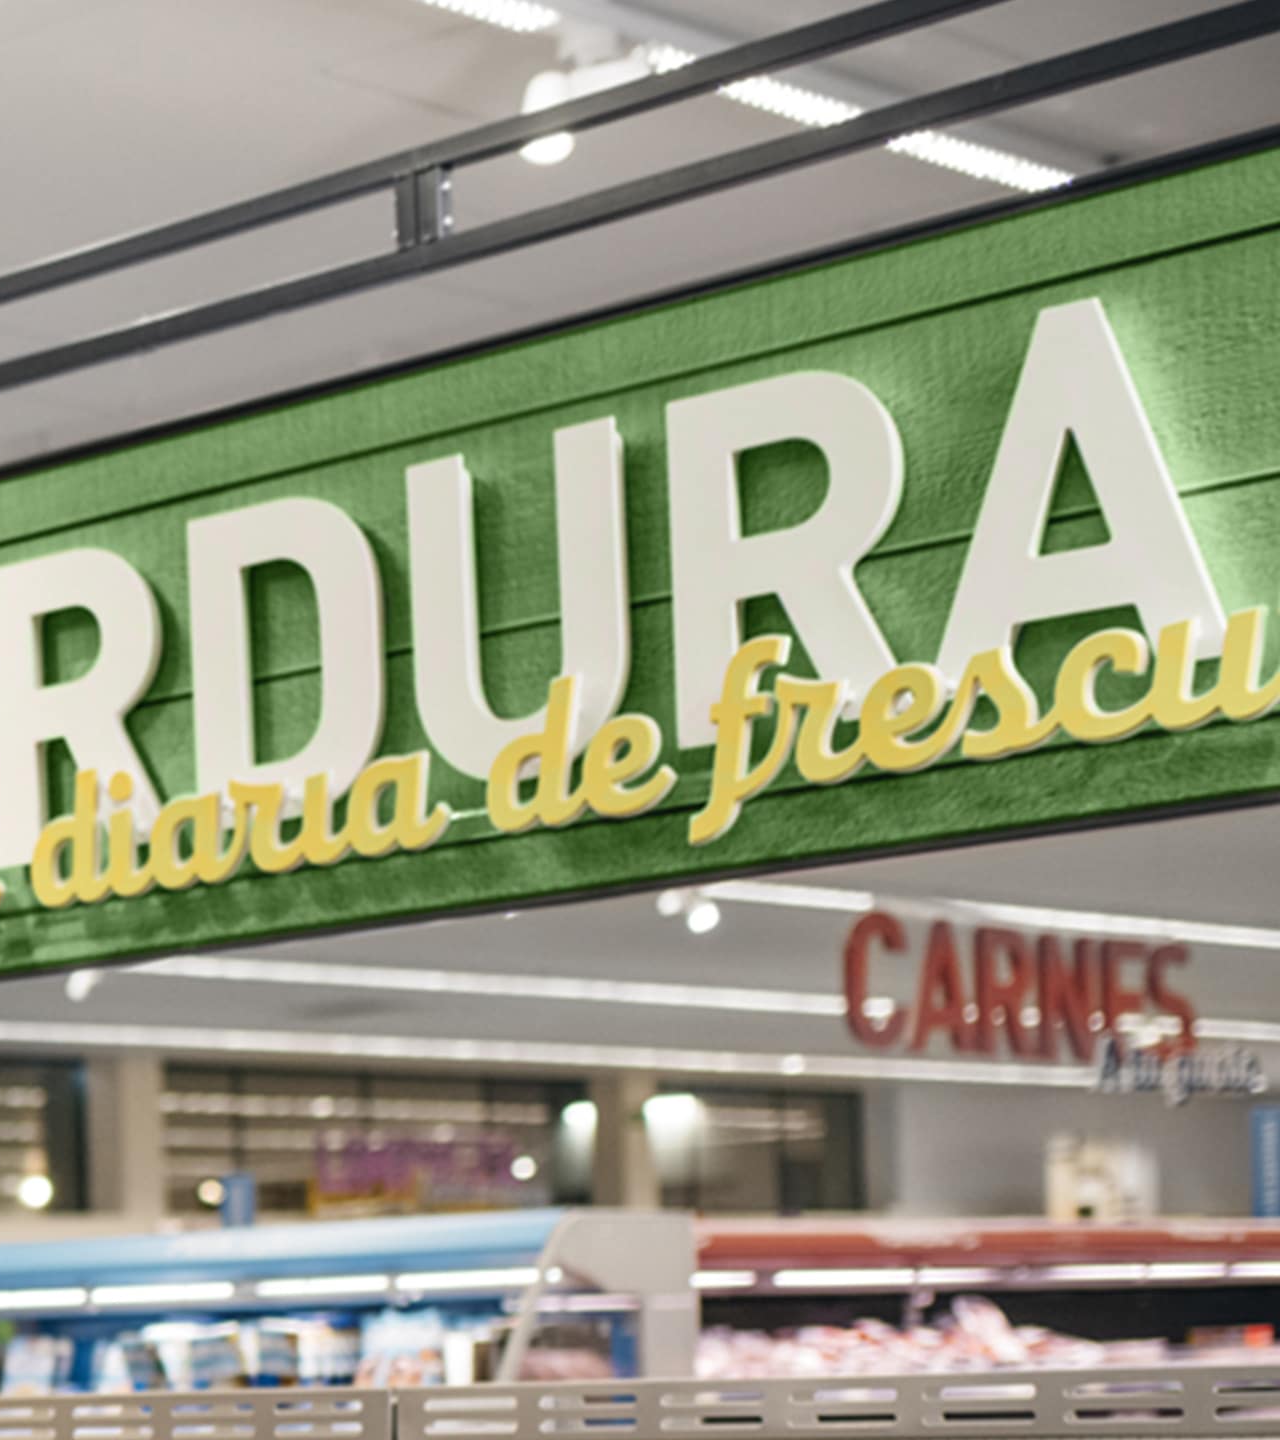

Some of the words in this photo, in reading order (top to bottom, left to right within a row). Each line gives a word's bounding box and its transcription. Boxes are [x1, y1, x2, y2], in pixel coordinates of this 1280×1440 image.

[32, 750, 452, 909] diaria
[487, 674, 676, 833] de
[688, 605, 1280, 845] frescu
[844, 911, 1198, 1064] CARNES
